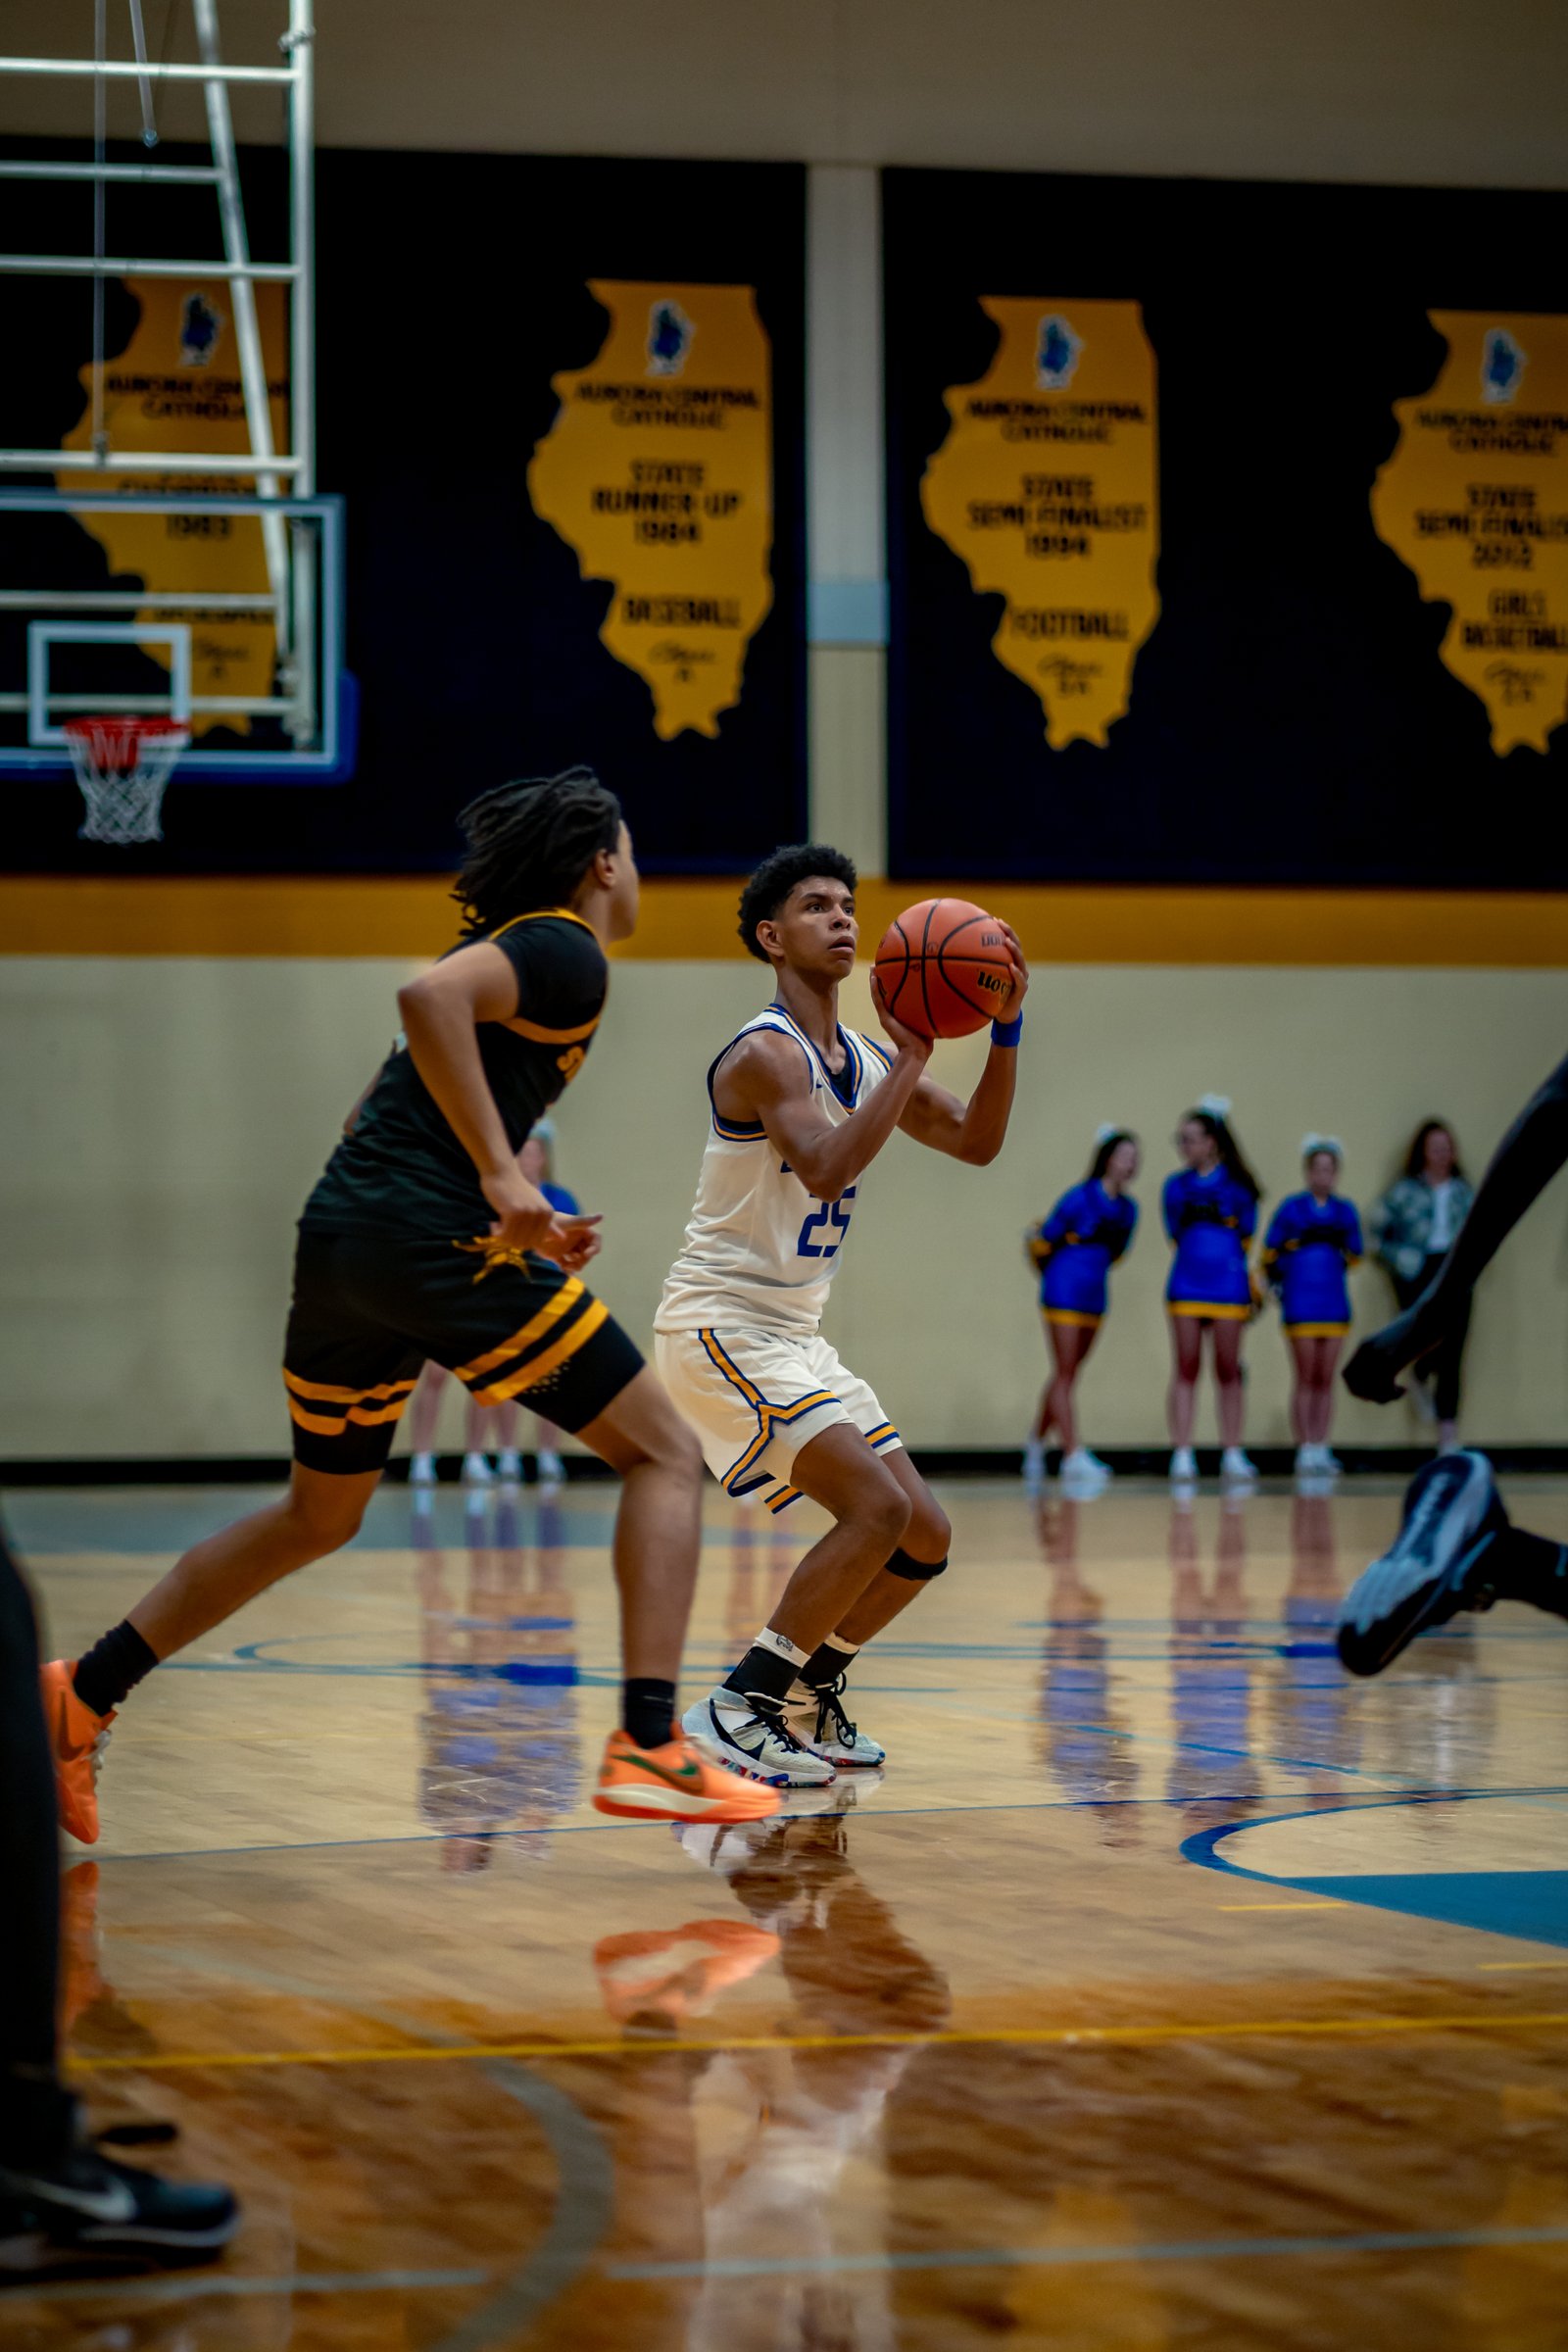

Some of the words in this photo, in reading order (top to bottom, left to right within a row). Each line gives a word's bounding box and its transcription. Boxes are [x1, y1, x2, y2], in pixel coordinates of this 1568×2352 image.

[622, 597, 741, 625] BASEBALL
[1012, 610, 1129, 640] FOOTBALL
[797, 1185, 857, 1257] 25
